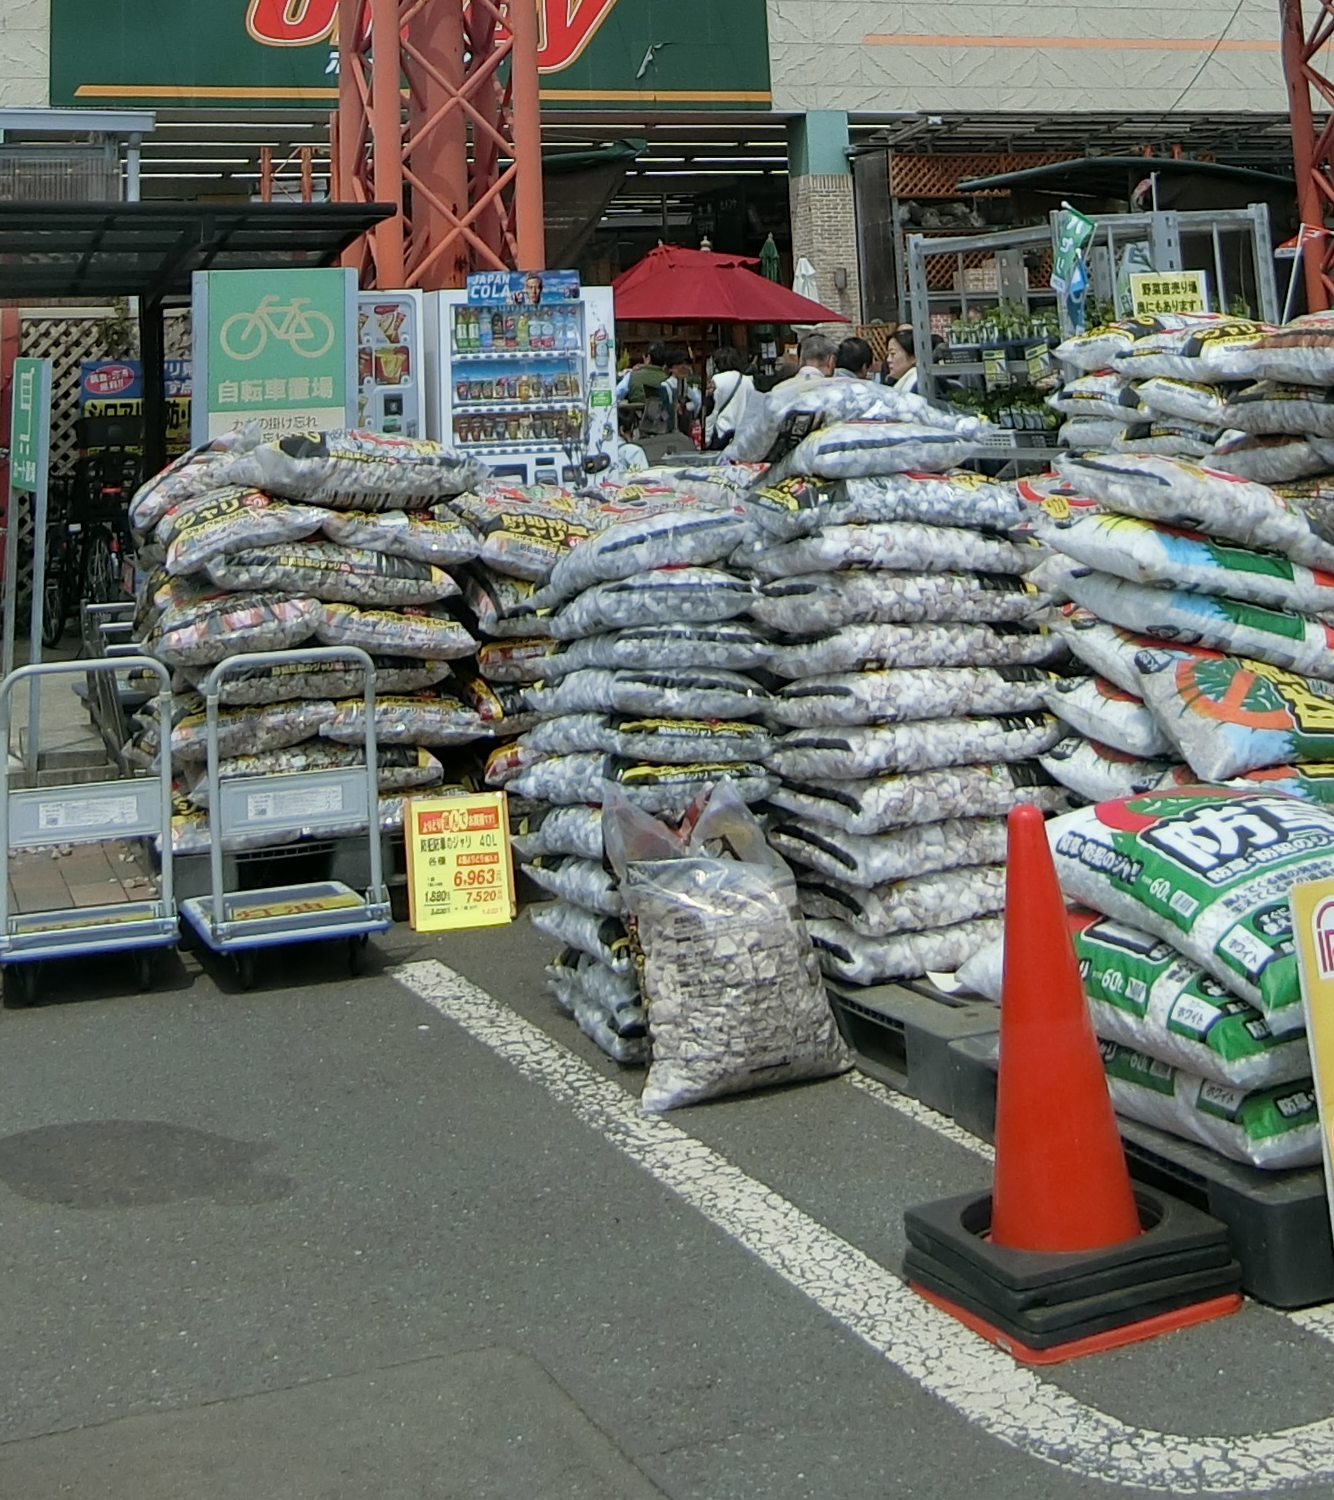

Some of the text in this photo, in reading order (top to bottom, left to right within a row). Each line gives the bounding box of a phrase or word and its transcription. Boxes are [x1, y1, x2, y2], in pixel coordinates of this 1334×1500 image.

[471, 274, 511, 285] JAPAN
[470, 284, 511, 299] COLA
[1141, 281, 1198, 296] 野菜苗売り場
[218, 376, 334, 404] 自転車置場
[232, 415, 318, 431] カの掛け忘れ
[479, 834, 498, 847] 40L
[454, 868, 496, 887] 6,963
[466, 890, 497, 904] 7,520
[1227, 938, 1258, 964] ホワイト
[1176, 1006, 1205, 1025] ホワイト
[1205, 1084, 1236, 1105] ホワイト
